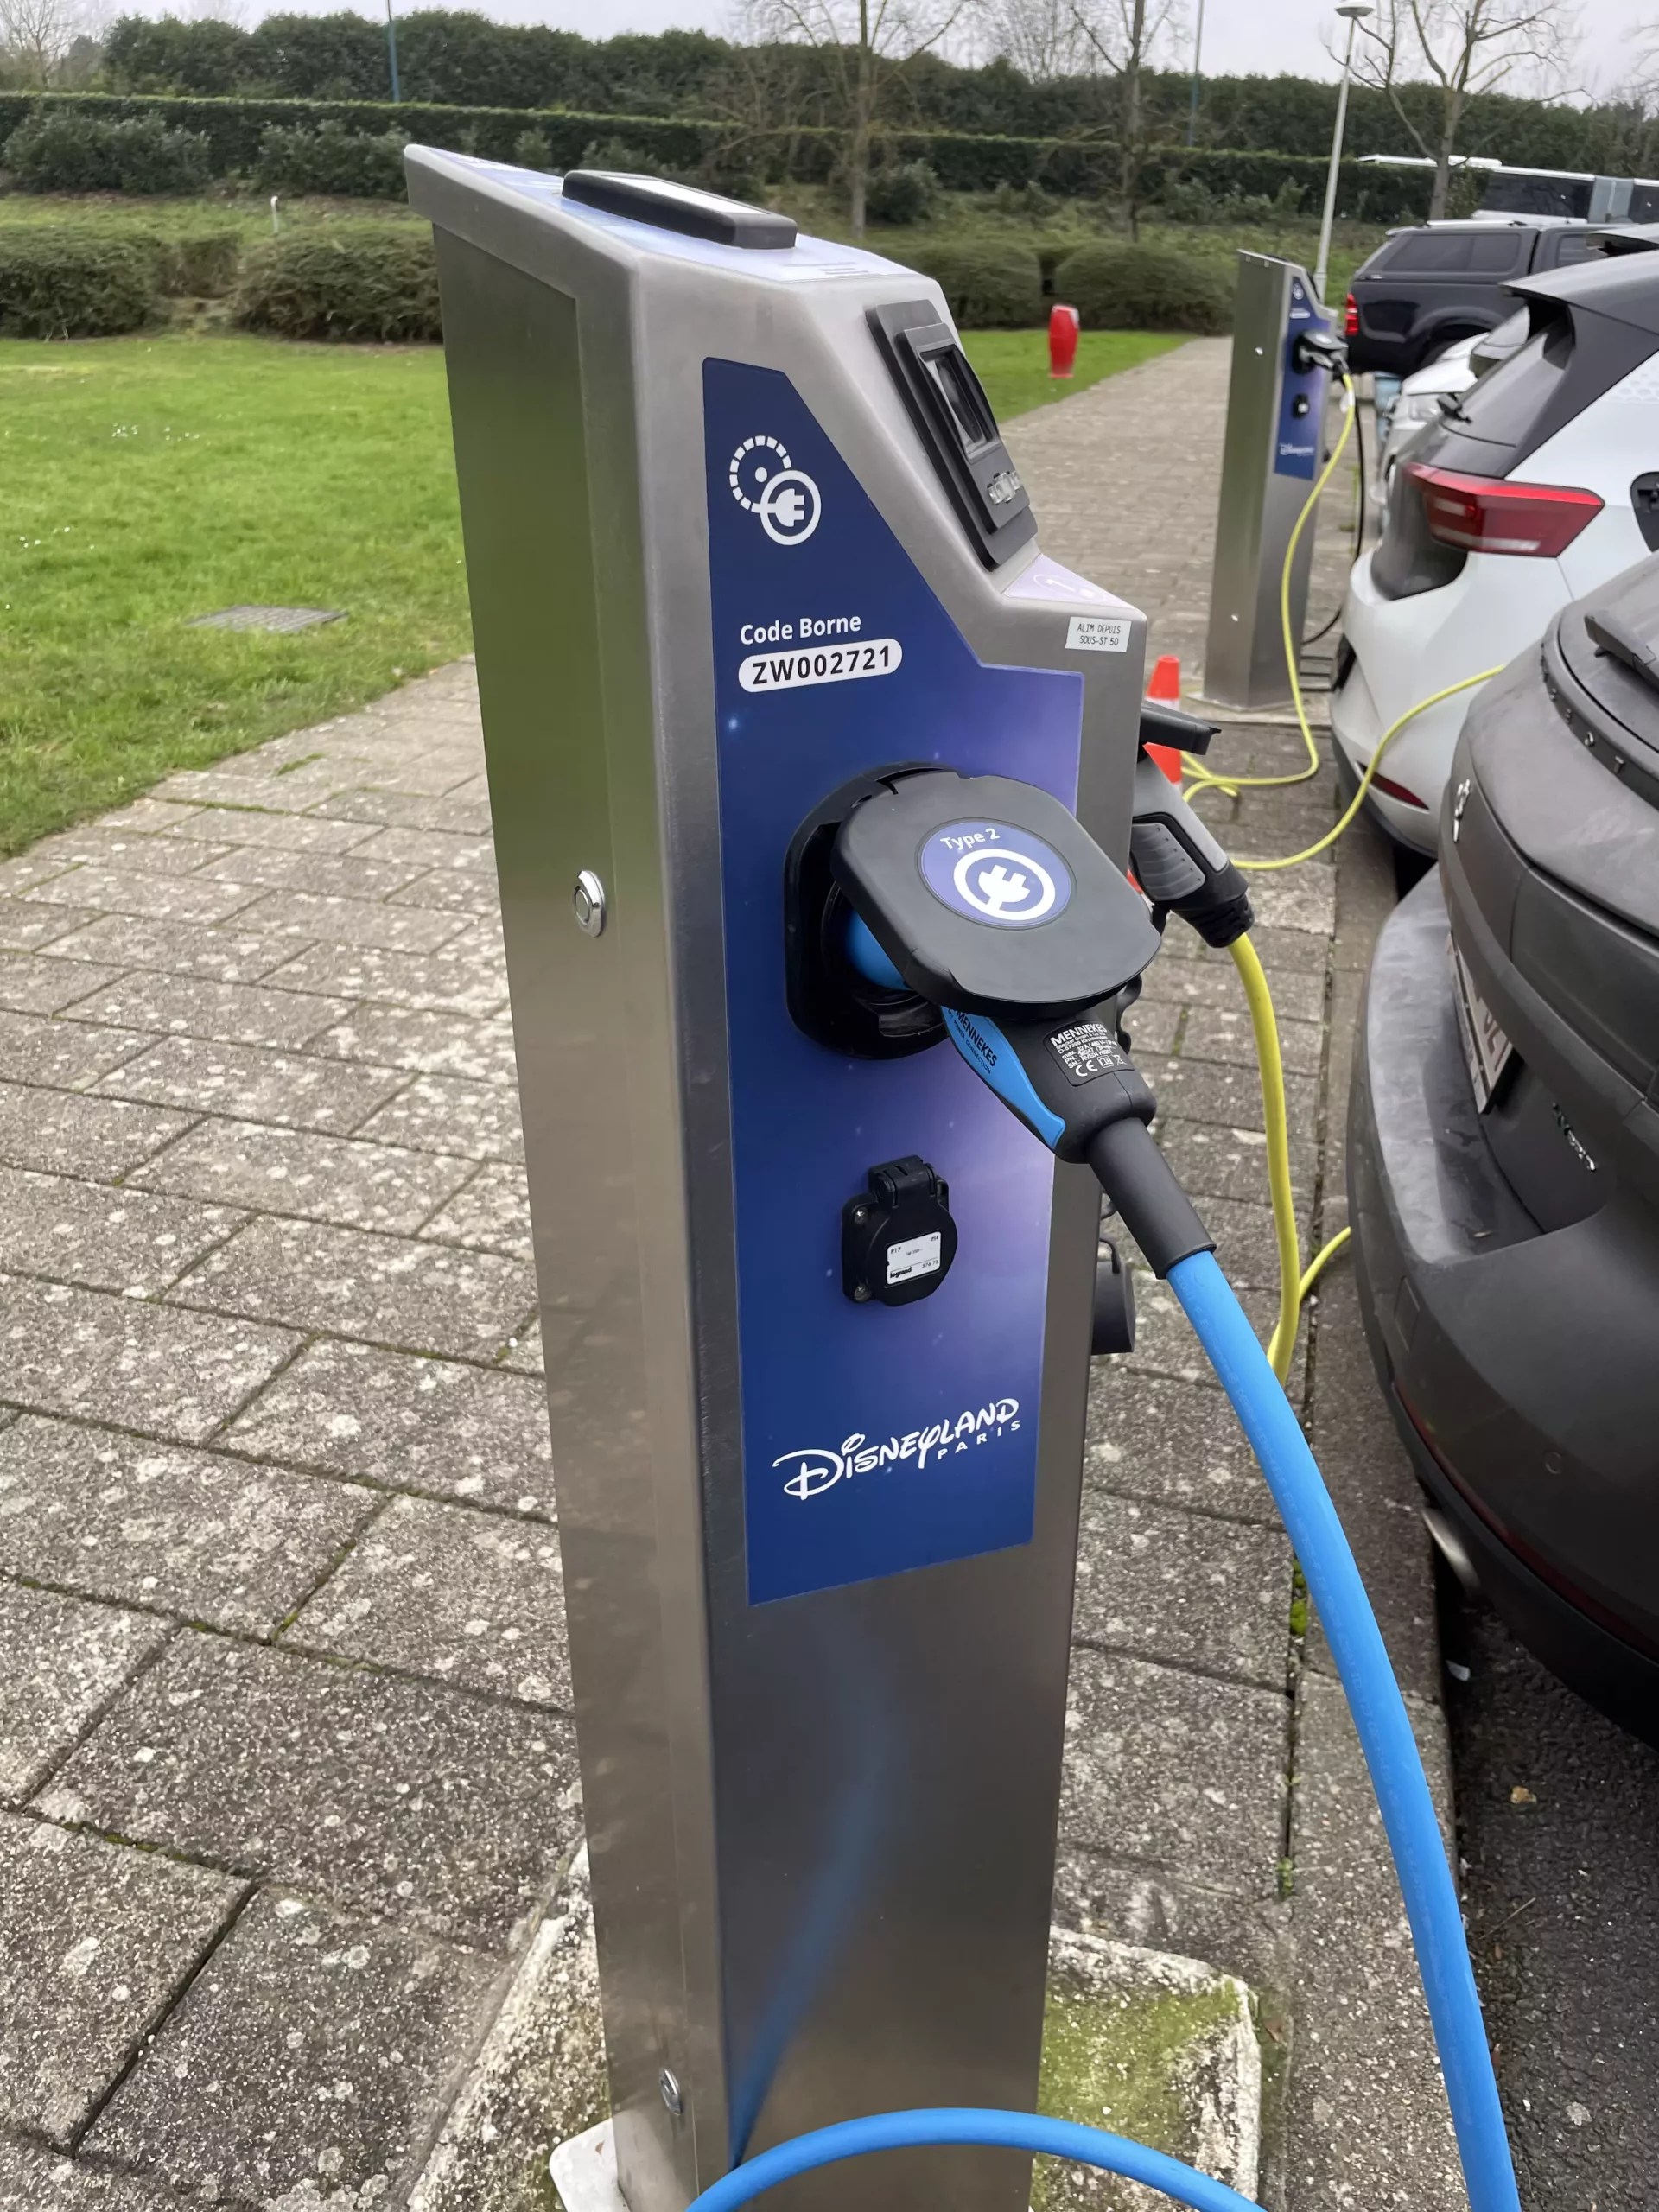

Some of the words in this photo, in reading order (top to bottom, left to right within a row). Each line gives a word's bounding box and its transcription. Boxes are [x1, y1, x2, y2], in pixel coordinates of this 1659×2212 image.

[740, 620, 794, 645] Code
[799, 615, 861, 639] Borne
[1077, 623, 1095, 632] ALIM
[1097, 625, 1121, 634] DEPUIS
[1079, 635, 1108, 645] SOUS-ST
[1109, 638, 1119, 646] 50
[753, 645, 889, 685] ZW002721
[940, 832, 986, 851] Type
[985, 828, 1001, 841] 2
[957, 1010, 998, 1067] MENNEKES
[1050, 1024, 1108, 1046] MENNEKES
[890, 1266, 912, 1279] legrand
[938, 1420, 1020, 1460] PARIS
